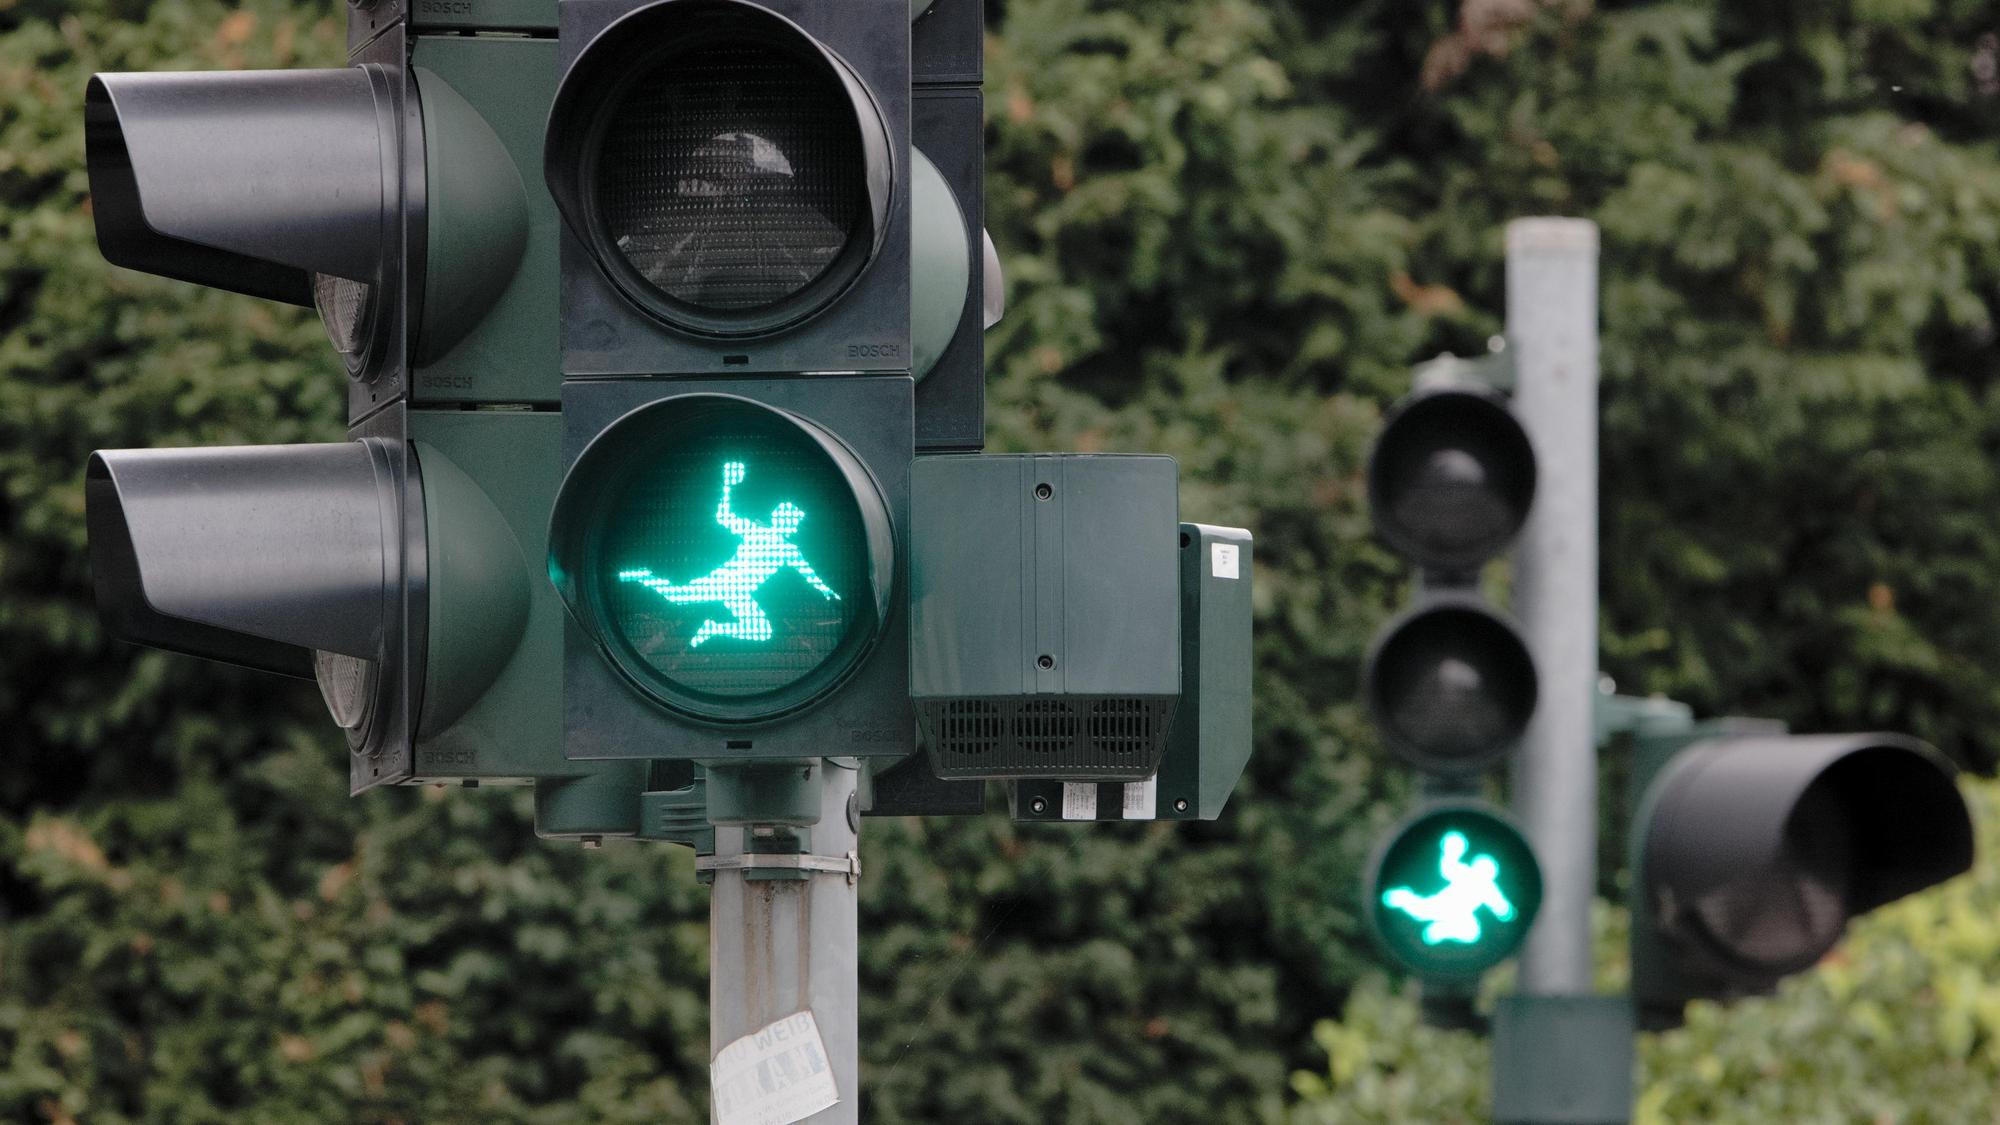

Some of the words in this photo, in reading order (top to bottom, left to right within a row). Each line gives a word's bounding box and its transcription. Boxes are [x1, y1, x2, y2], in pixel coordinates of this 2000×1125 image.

[421, 1, 472, 14] BOSCH
[848, 344, 900, 357] BOSCH
[421, 375, 473, 388] BOSCH
[423, 750, 476, 764] BOSCH
